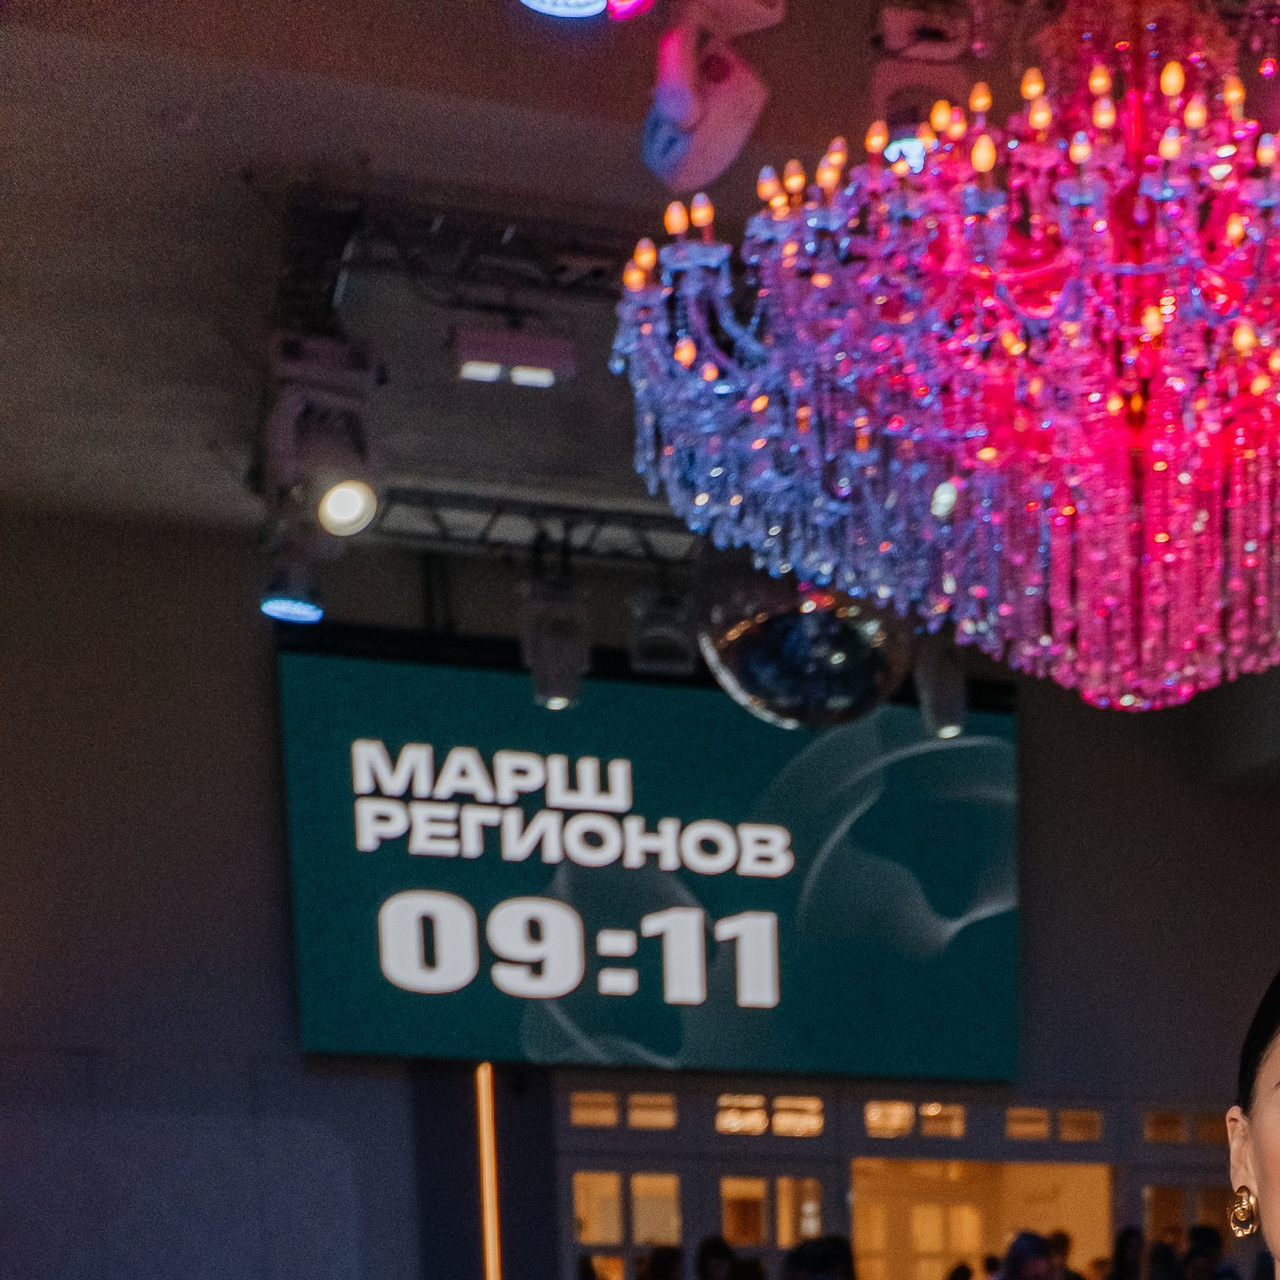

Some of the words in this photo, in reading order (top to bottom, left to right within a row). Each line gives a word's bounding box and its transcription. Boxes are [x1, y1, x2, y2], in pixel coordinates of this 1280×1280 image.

[351, 739, 633, 813] МАРШ
[354, 797, 795, 878] РЕГИОНОВ
[378, 889, 780, 1009] 09:11
